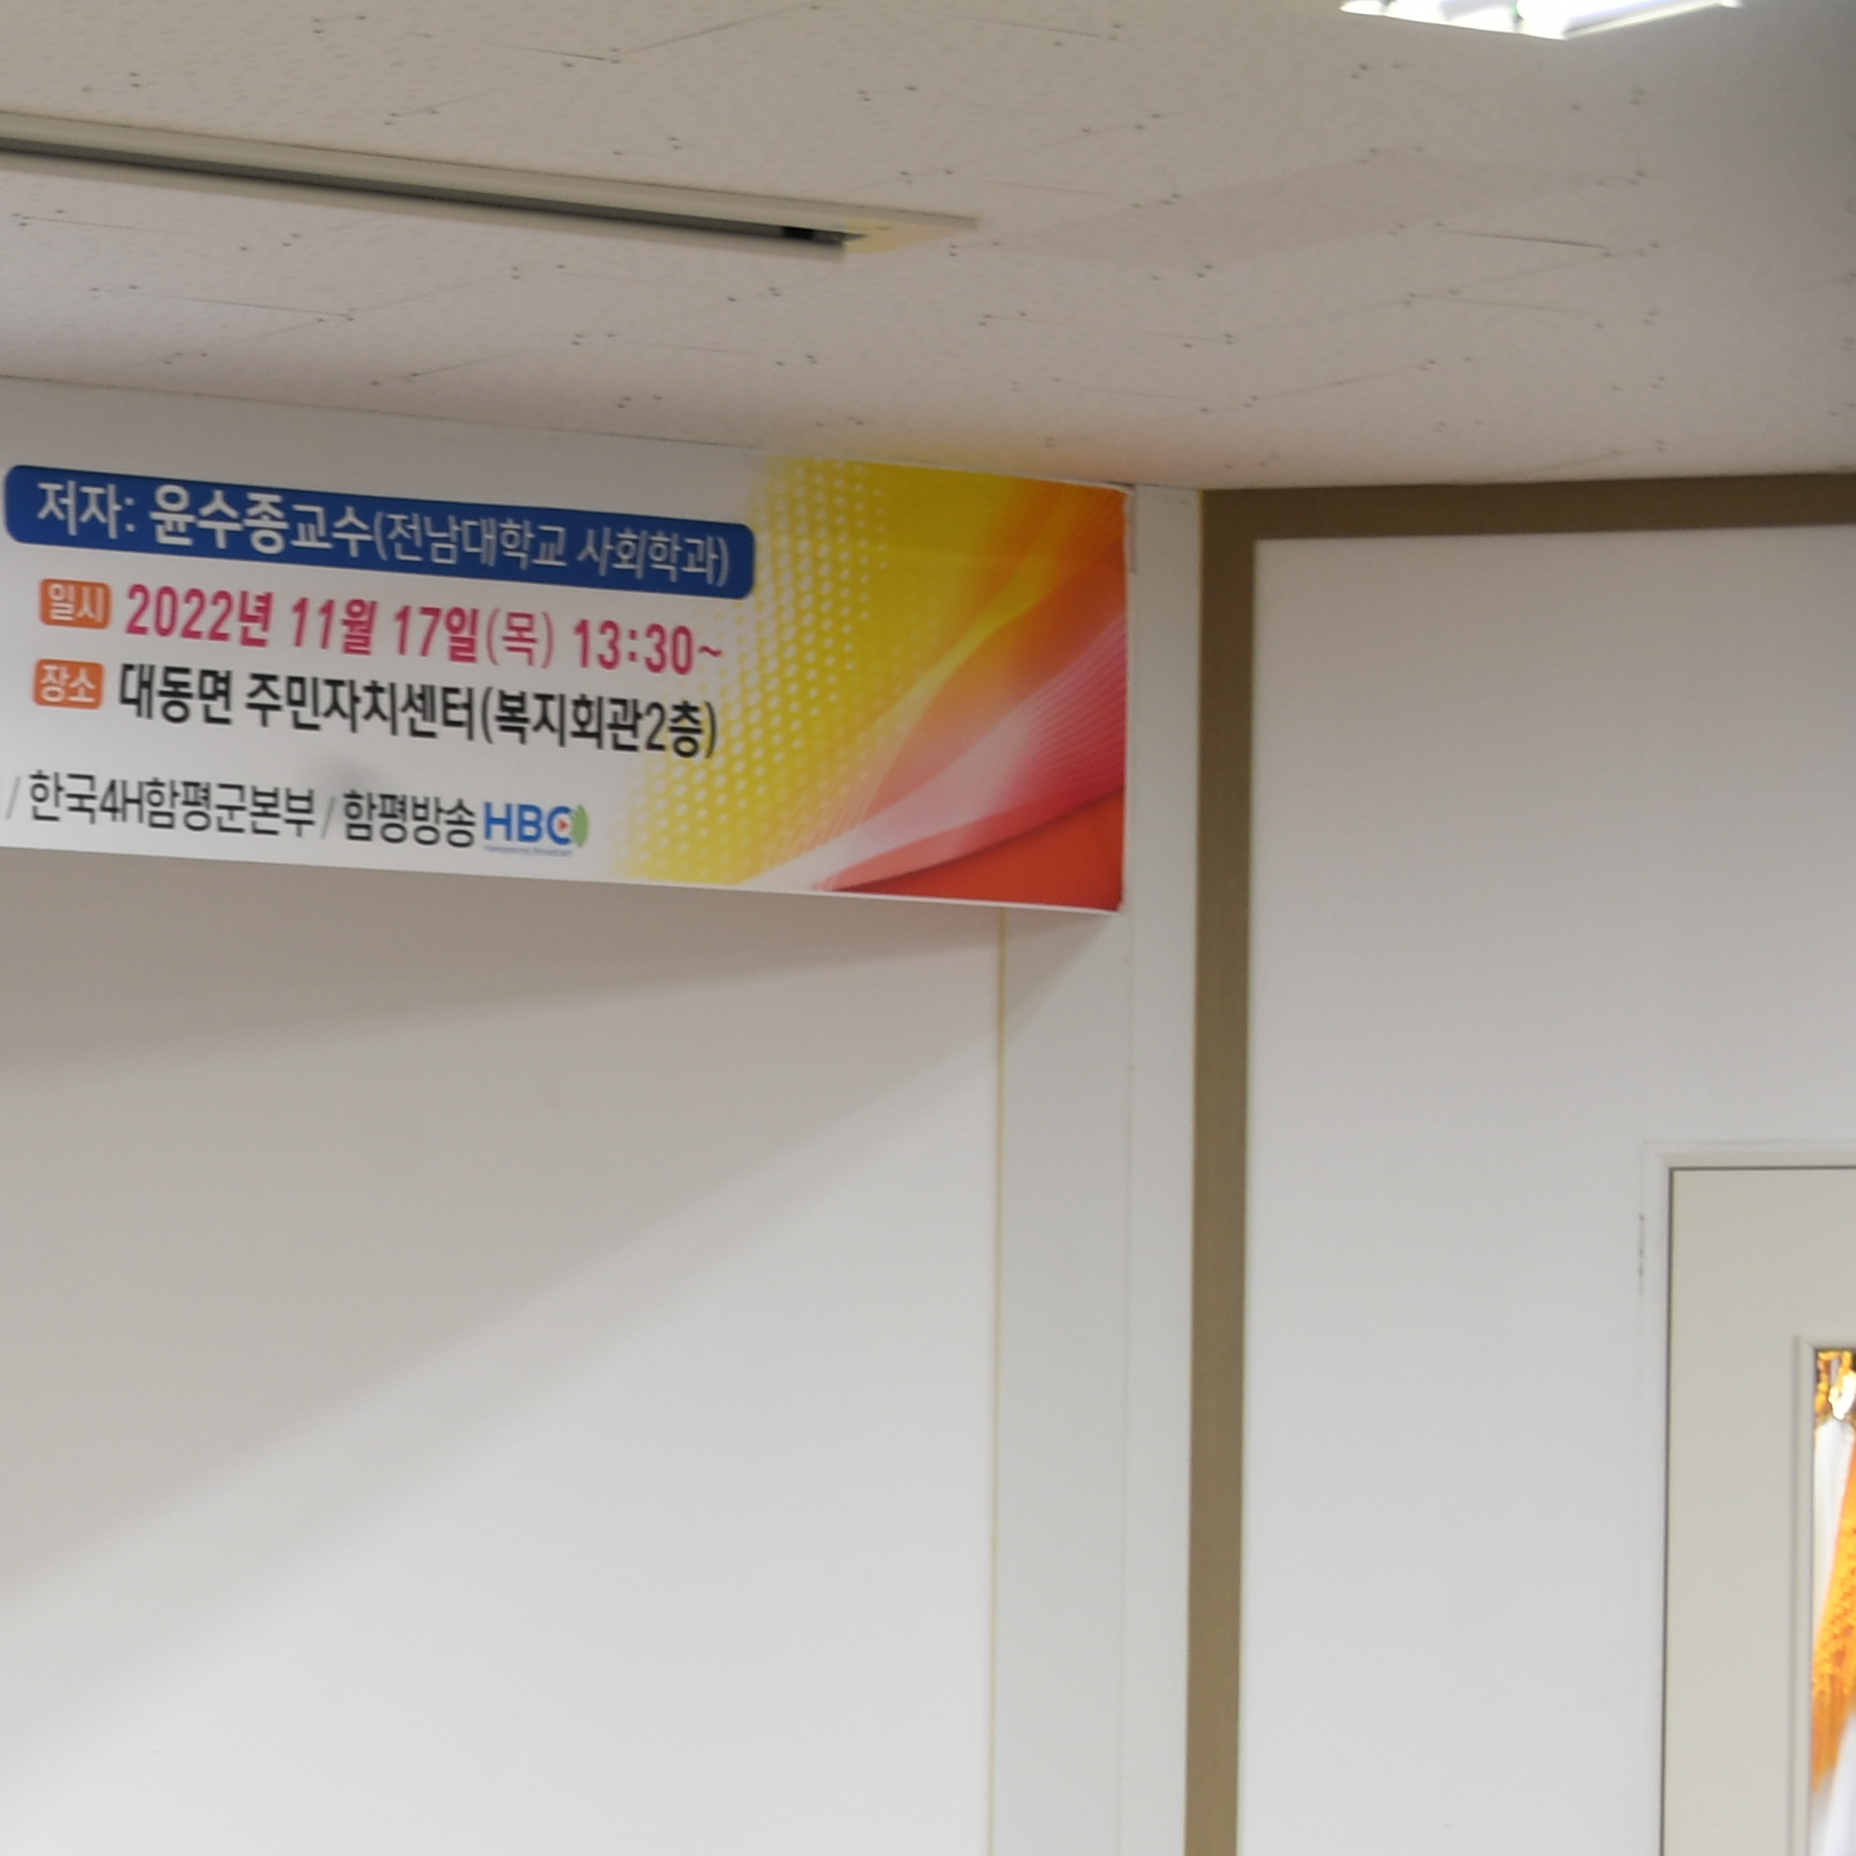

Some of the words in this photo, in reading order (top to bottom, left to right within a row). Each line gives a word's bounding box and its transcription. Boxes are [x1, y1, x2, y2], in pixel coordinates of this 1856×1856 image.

[36, 480, 135, 540] 저자:
[575, 526, 730, 588] 사회학과)
[47, 582, 105, 624] 일시
[125, 583, 274, 648] 2022년
[291, 597, 378, 657] 11월
[393, 605, 555, 670] 17일(목)
[573, 618, 724, 676] 13:30~
[39, 663, 97, 704] 장소
[119, 663, 233, 726] 대동면
[483, 801, 573, 846] HBC
